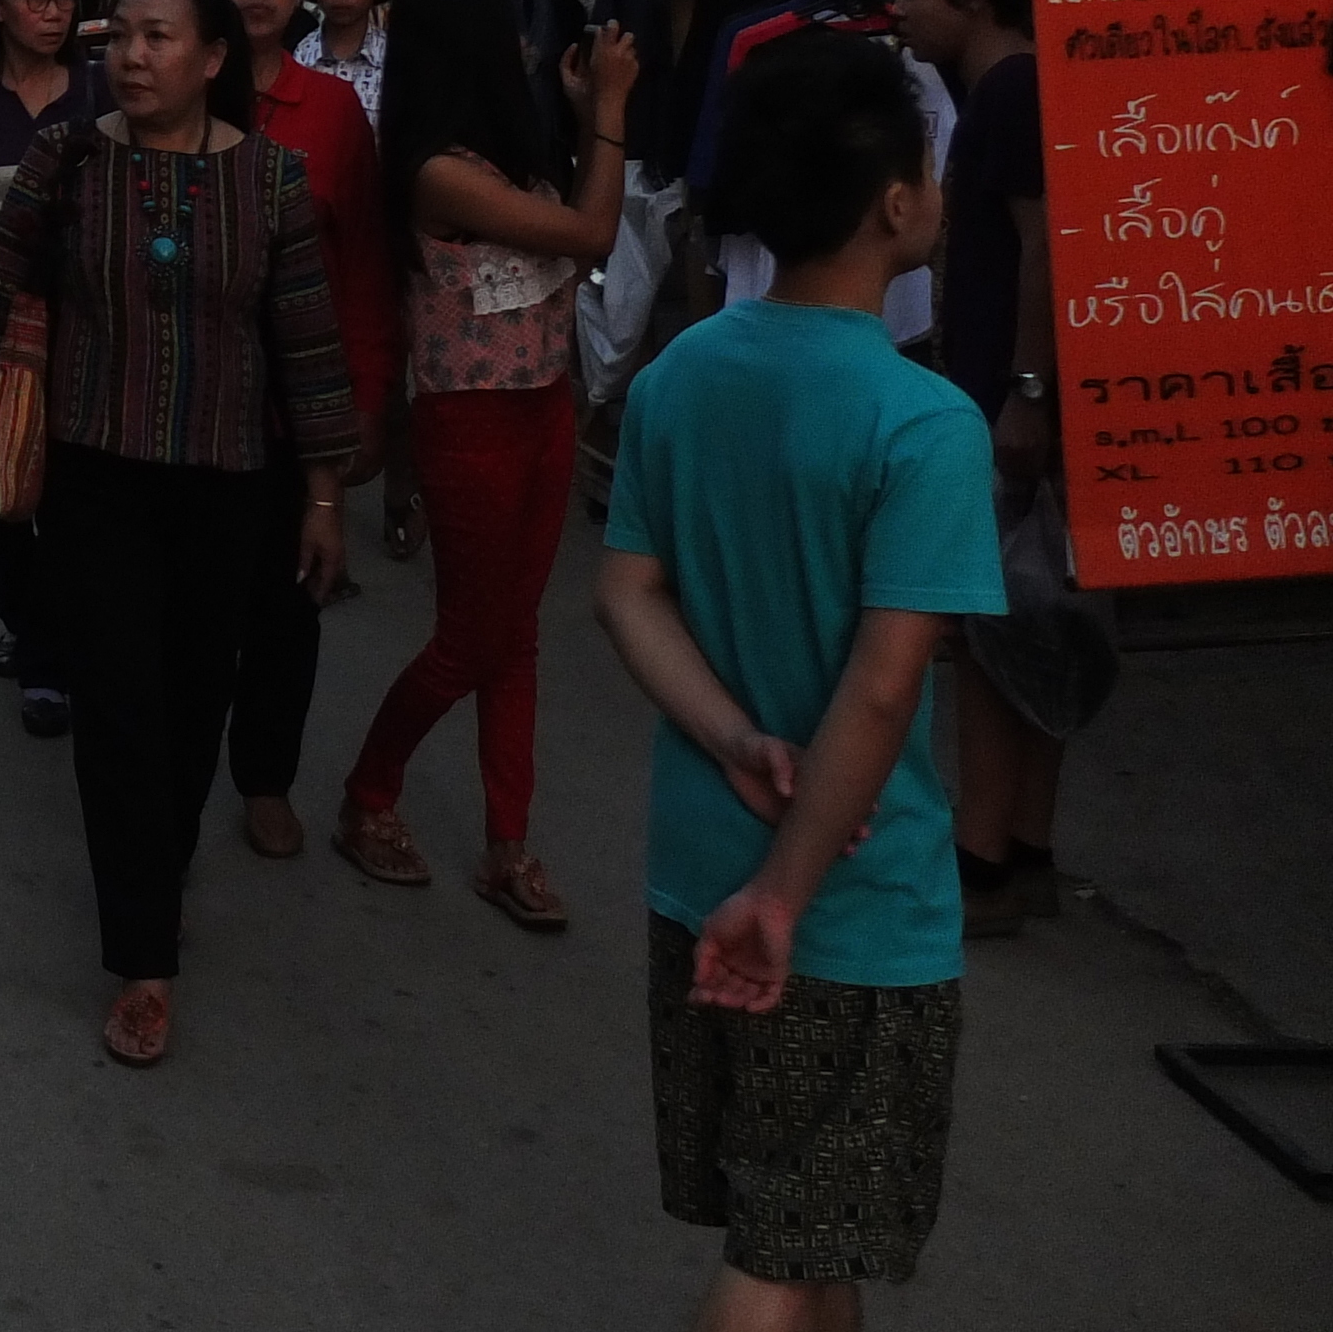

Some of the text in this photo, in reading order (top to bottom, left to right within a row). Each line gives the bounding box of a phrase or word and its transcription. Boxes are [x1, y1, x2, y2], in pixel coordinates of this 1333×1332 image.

[1103, 174, 1226, 252] เสื้อคู่
[1221, 414, 1300, 439] 100
[1094, 452, 1305, 482] XL 110
[1117, 503, 1249, 561] ตัวอักษร
